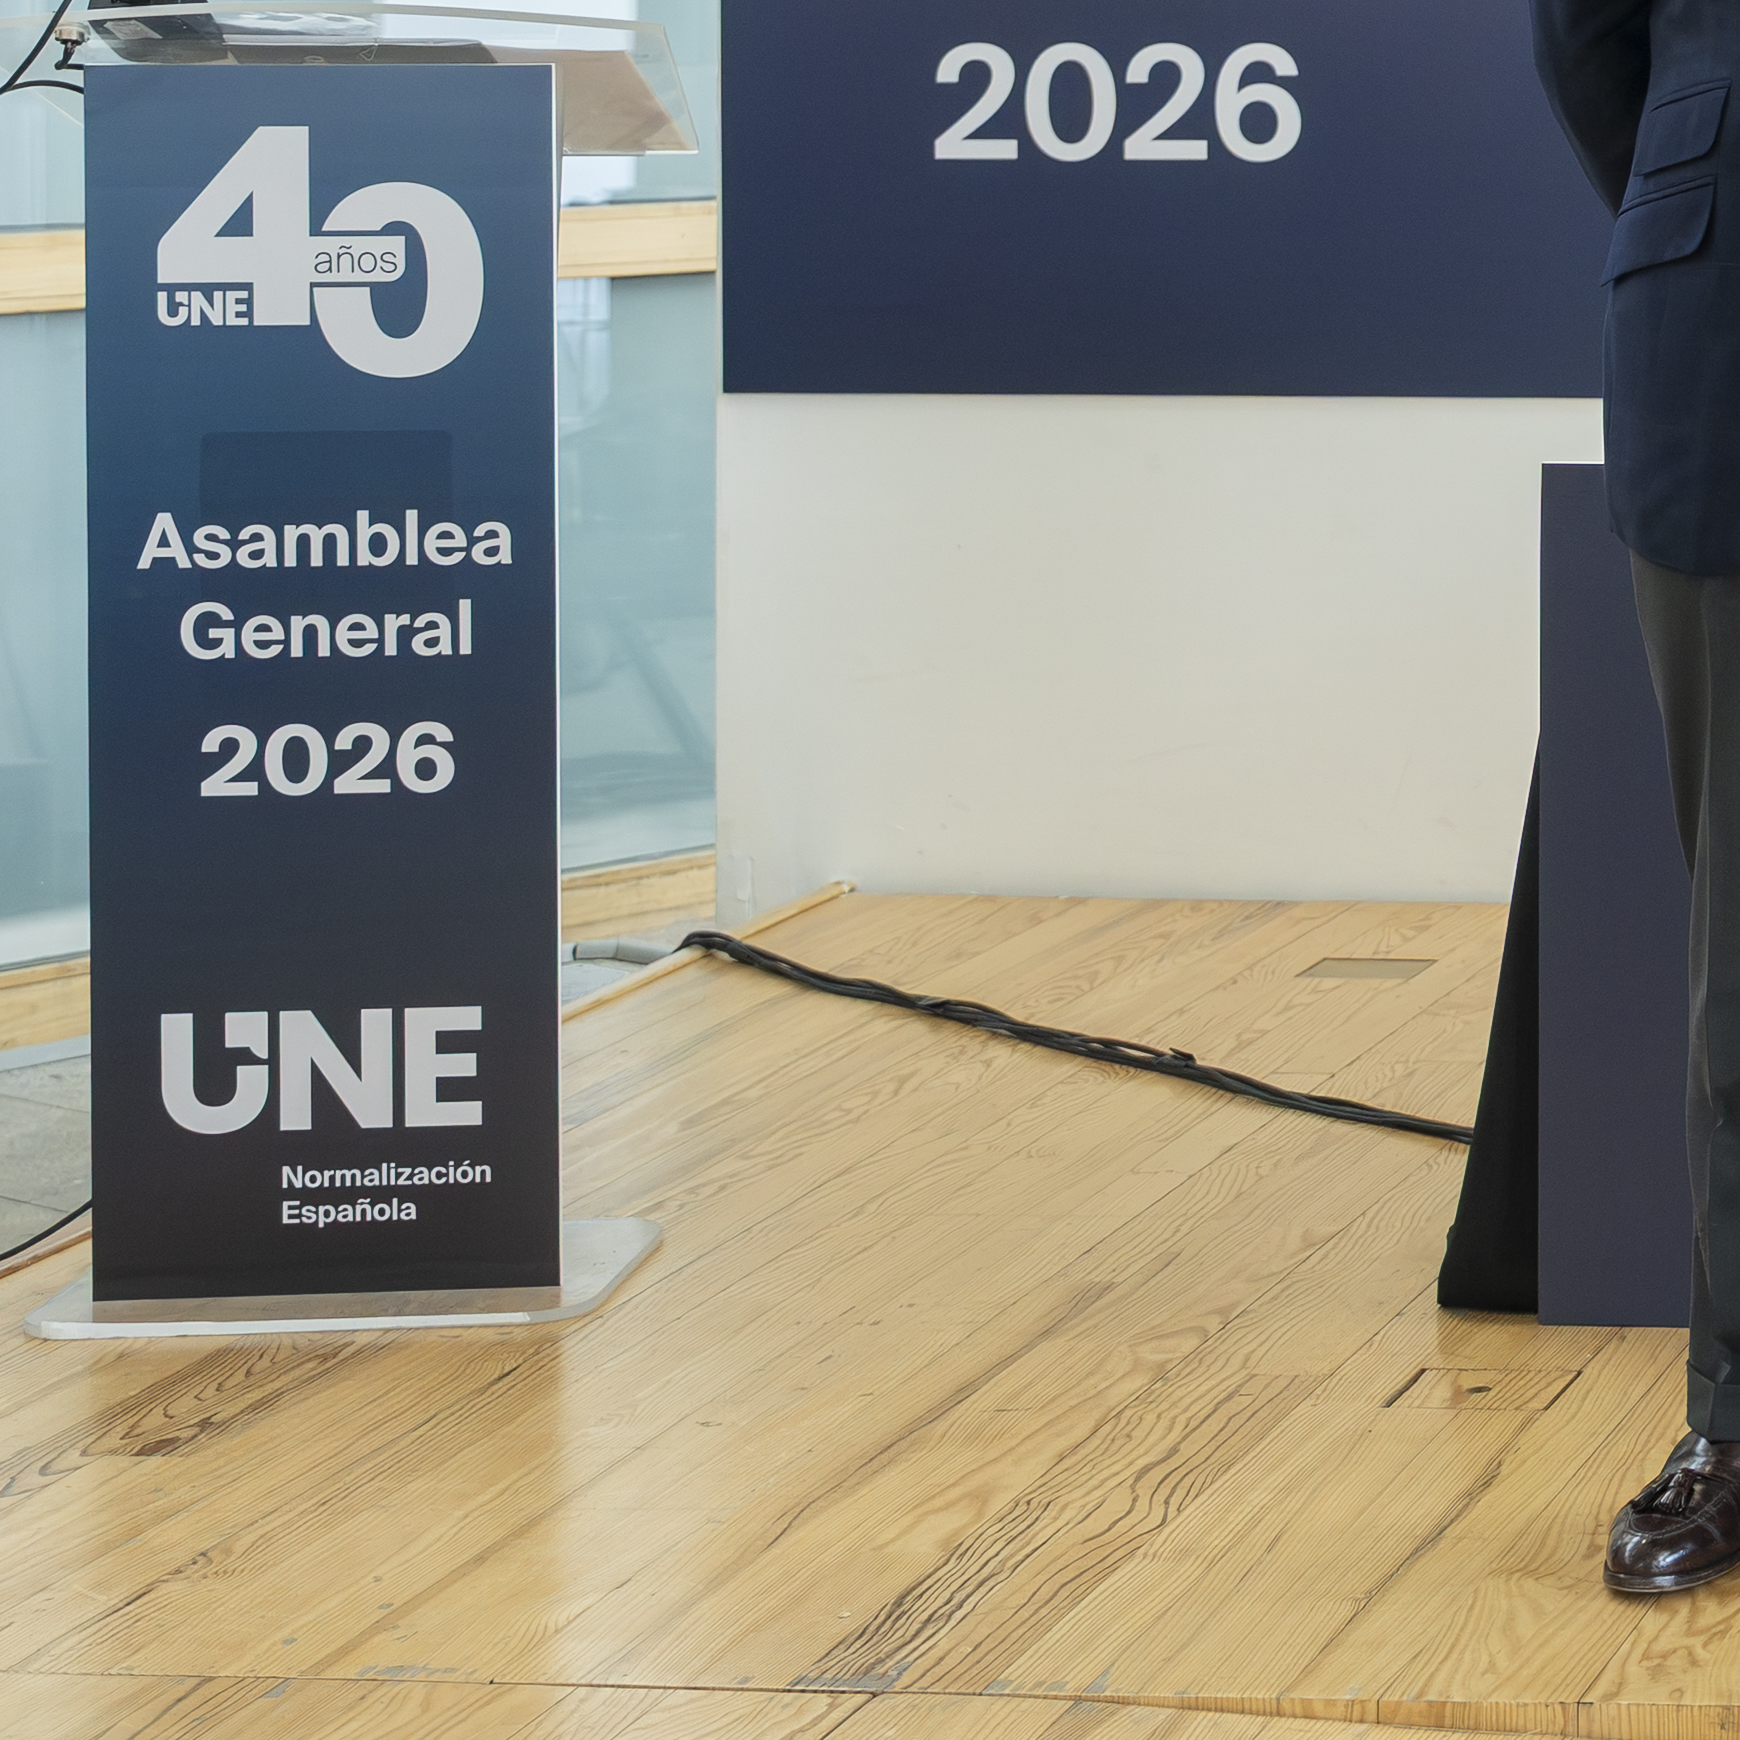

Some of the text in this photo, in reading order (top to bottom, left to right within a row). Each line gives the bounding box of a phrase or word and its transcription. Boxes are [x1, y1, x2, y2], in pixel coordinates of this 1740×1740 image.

[934, 42, 1302, 163] 2026
[156, 126, 484, 379] 40
[313, 244, 400, 276] años
[156, 289, 250, 327] UNE
[136, 509, 513, 570] Asamblea
[180, 598, 472, 660] General
[200, 721, 456, 797] 2026
[160, 1005, 483, 1135] UNE
[281, 1159, 492, 1189] Normalización
[282, 1197, 417, 1228] Española
